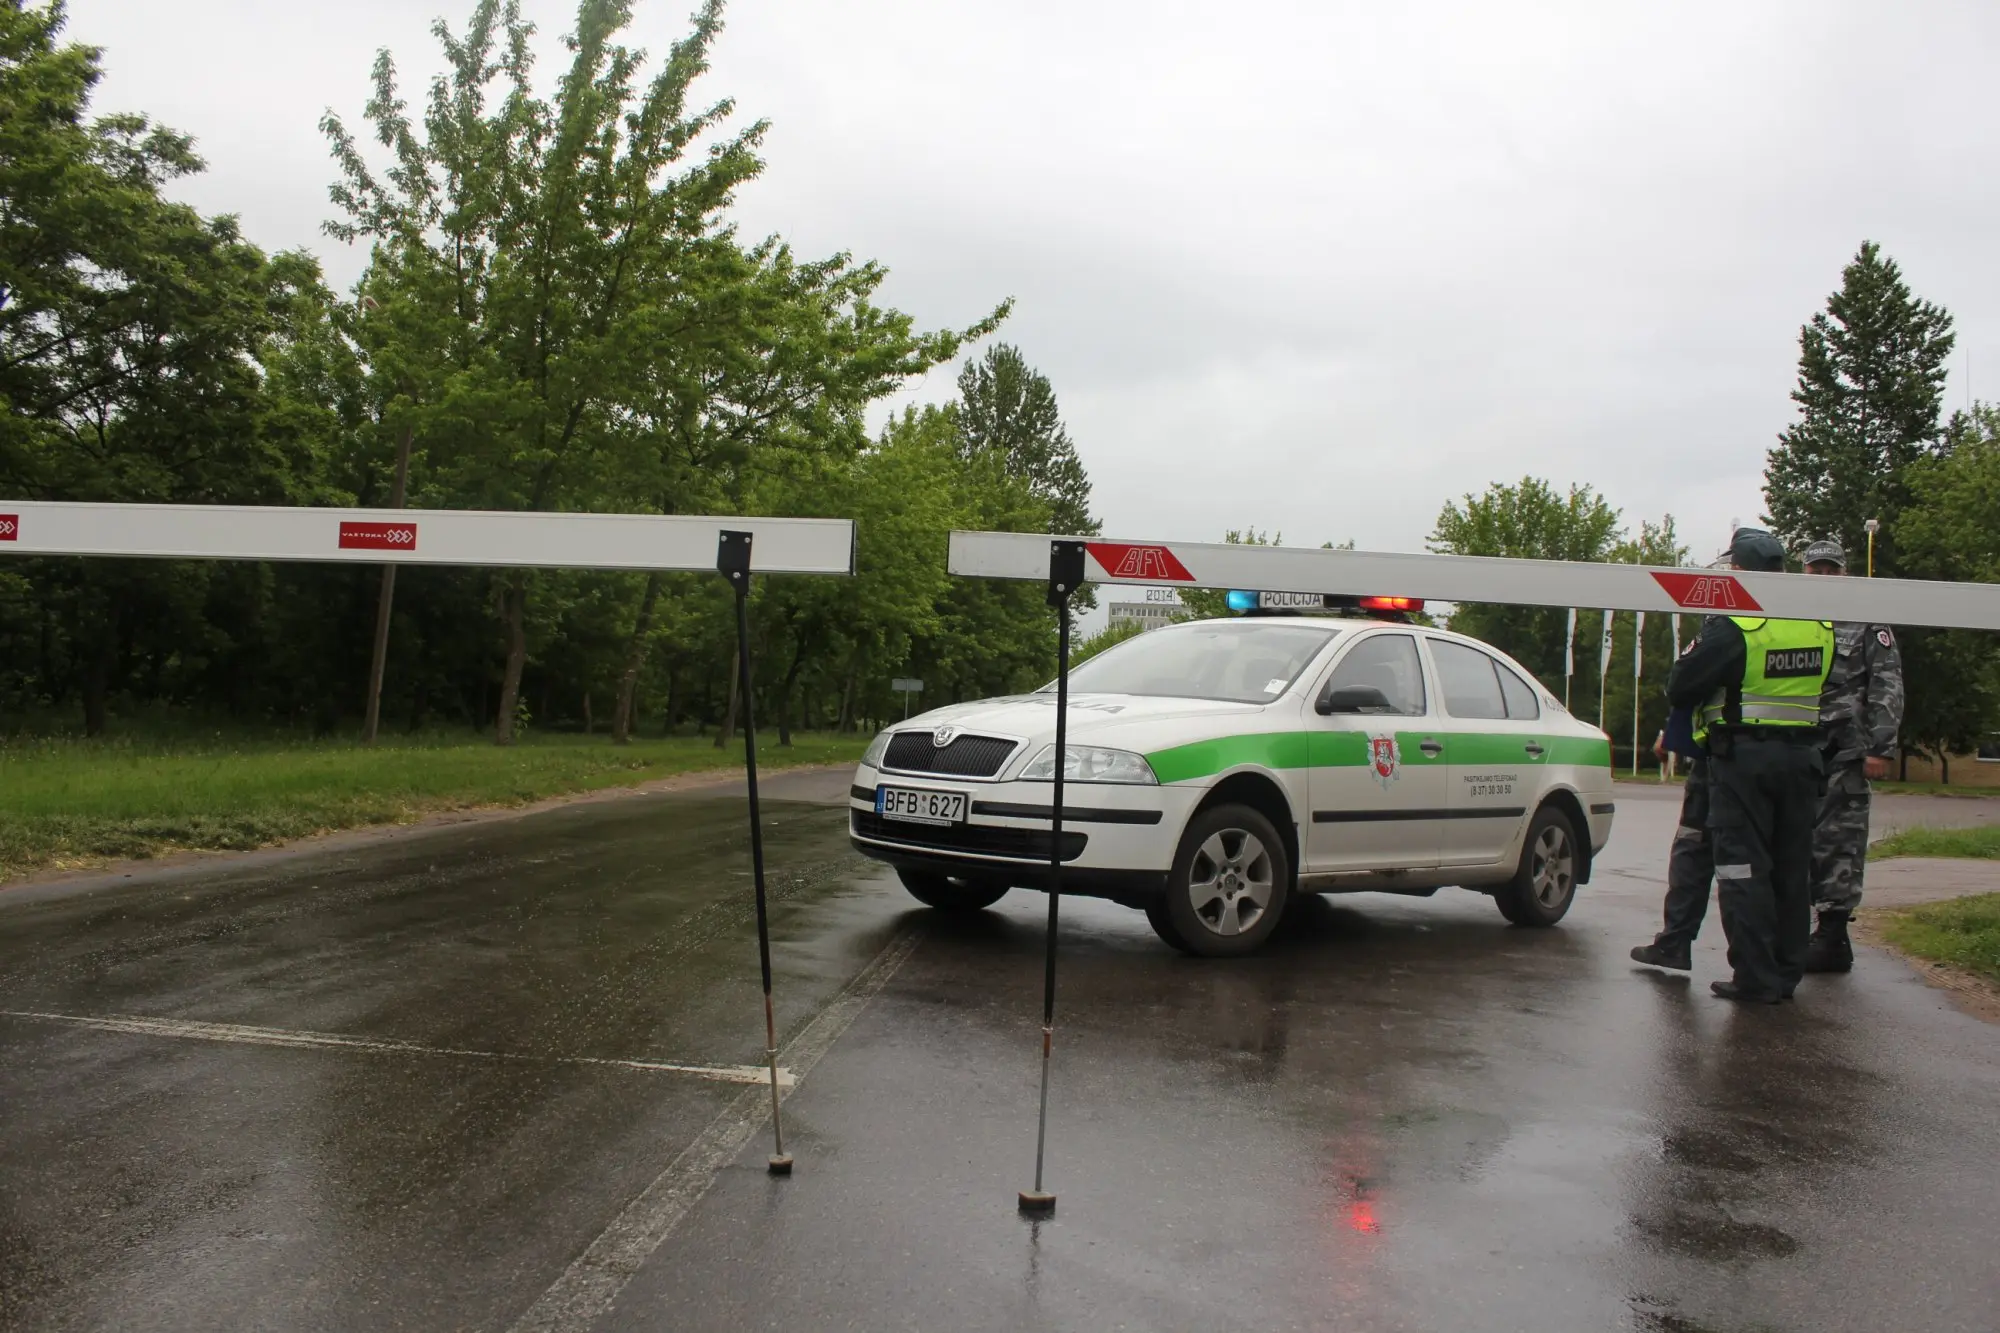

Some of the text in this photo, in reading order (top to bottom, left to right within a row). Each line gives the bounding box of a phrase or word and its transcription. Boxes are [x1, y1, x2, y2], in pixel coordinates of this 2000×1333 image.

[1114, 548, 1168, 577] BFT
[1146, 589, 1173, 601] 2014
[1264, 592, 1321, 606] POLICIJA
[1683, 578, 1736, 607] BFT
[1767, 651, 1822, 671] POLICIJA
[885, 790, 962, 818] BFB 627
